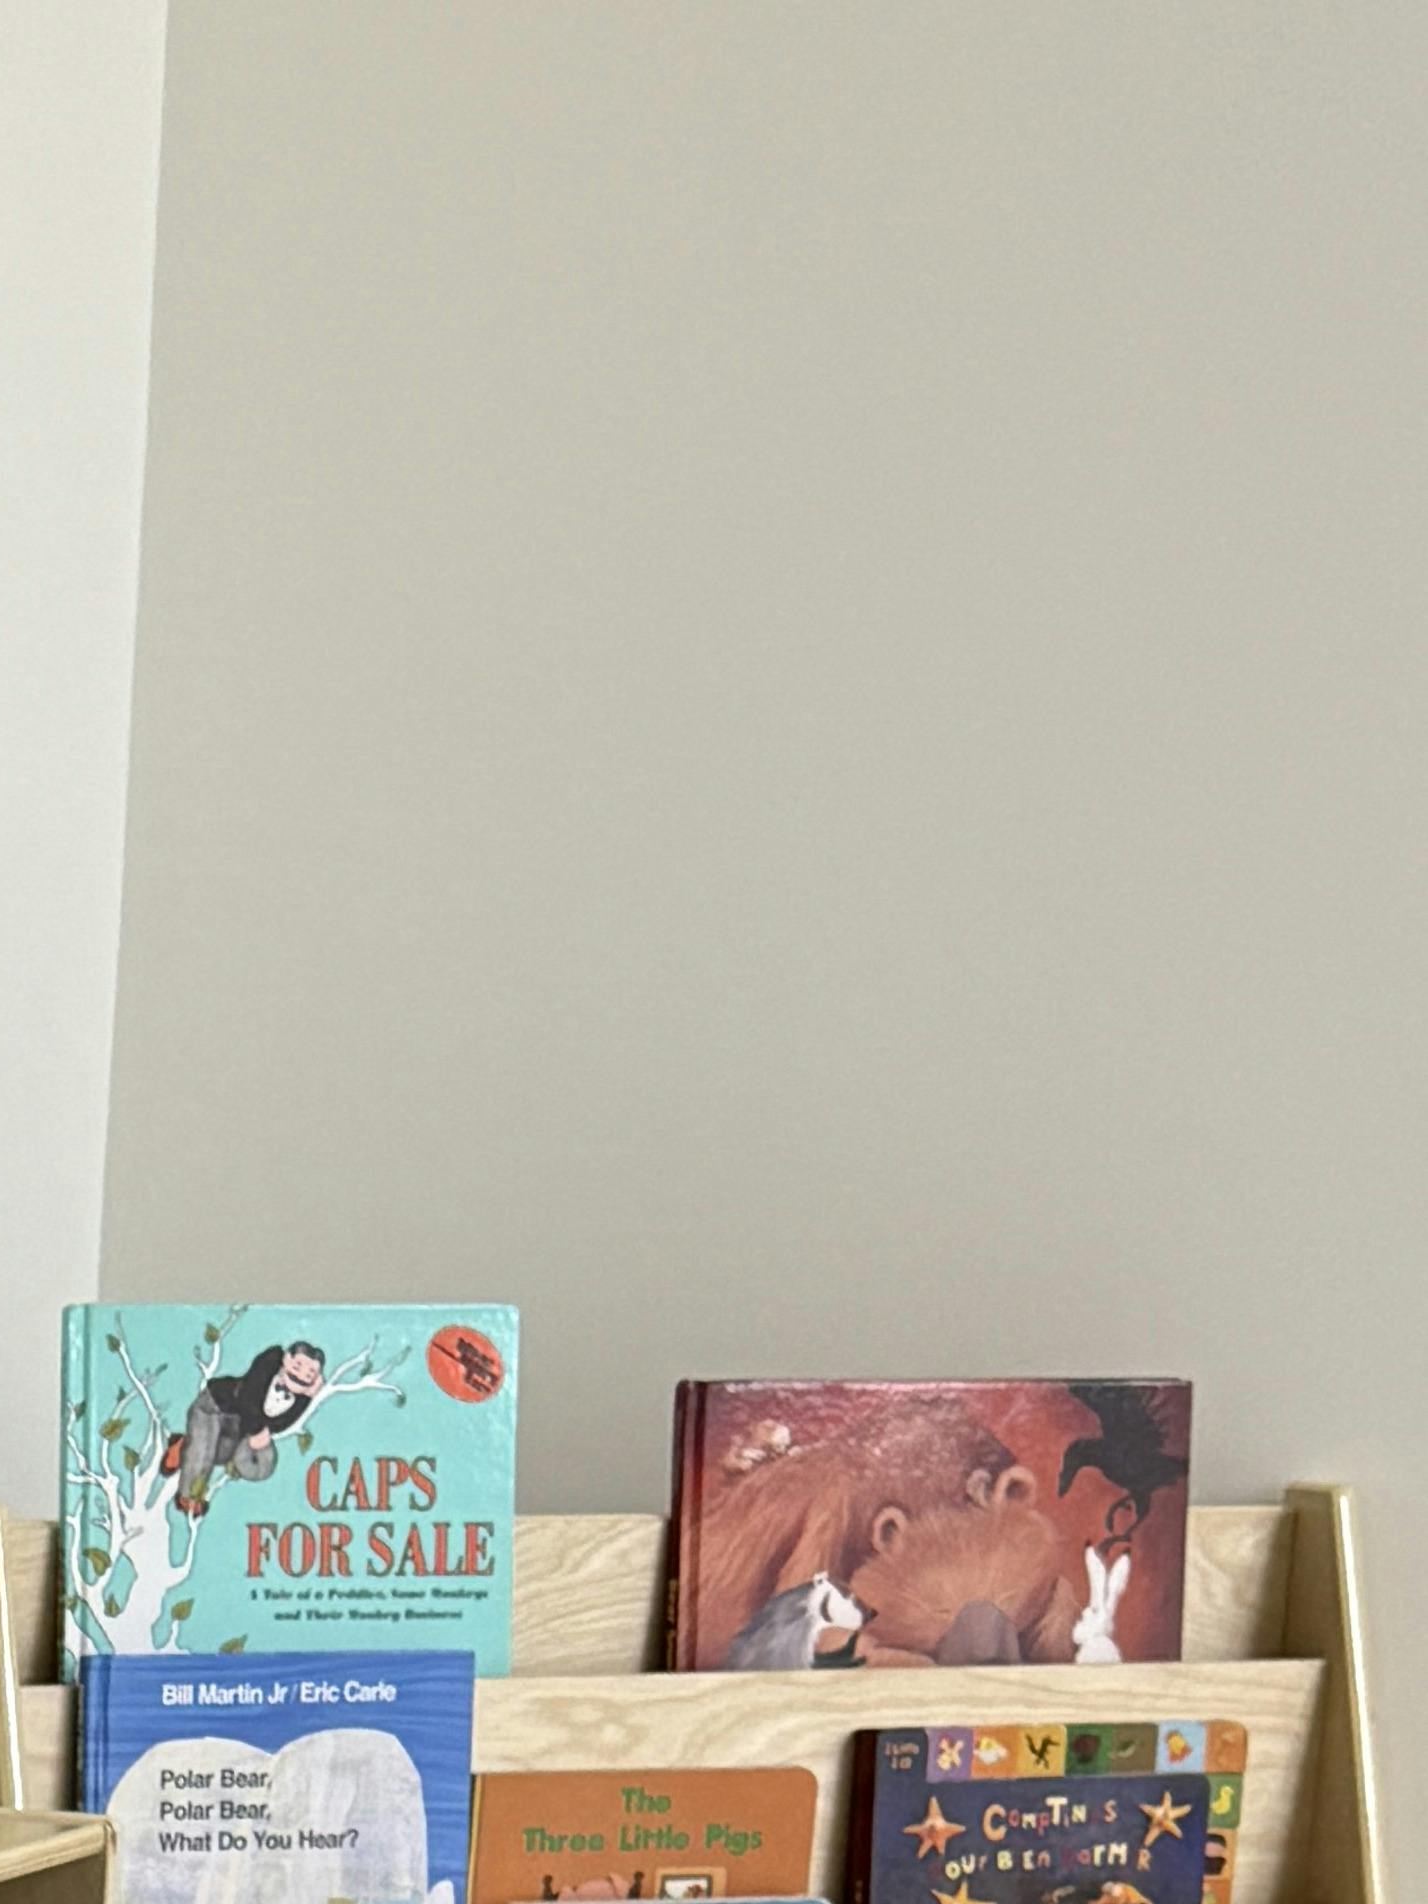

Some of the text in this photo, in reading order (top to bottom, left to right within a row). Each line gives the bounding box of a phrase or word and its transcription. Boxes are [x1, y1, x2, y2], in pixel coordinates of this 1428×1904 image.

[306, 1456, 437, 1512] CAPS
[245, 1522, 494, 1578] FOR SALE
[273, 1607, 463, 1622] and Their Monkey Business
[162, 1684, 192, 1705] Bill
[199, 1682, 264, 1705] Martin
[268, 1683, 289, 1704] Jr
[300, 1680, 340, 1703] Eric
[344, 1680, 397, 1703] Carle
[160, 1769, 273, 1790] Polar Bear,
[159, 1800, 273, 1822] Polar Bear,
[620, 1786, 672, 1815] The
[159, 1829, 360, 1852] What Do You Hear?
[523, 1823, 764, 1857] Three Little Pigs
